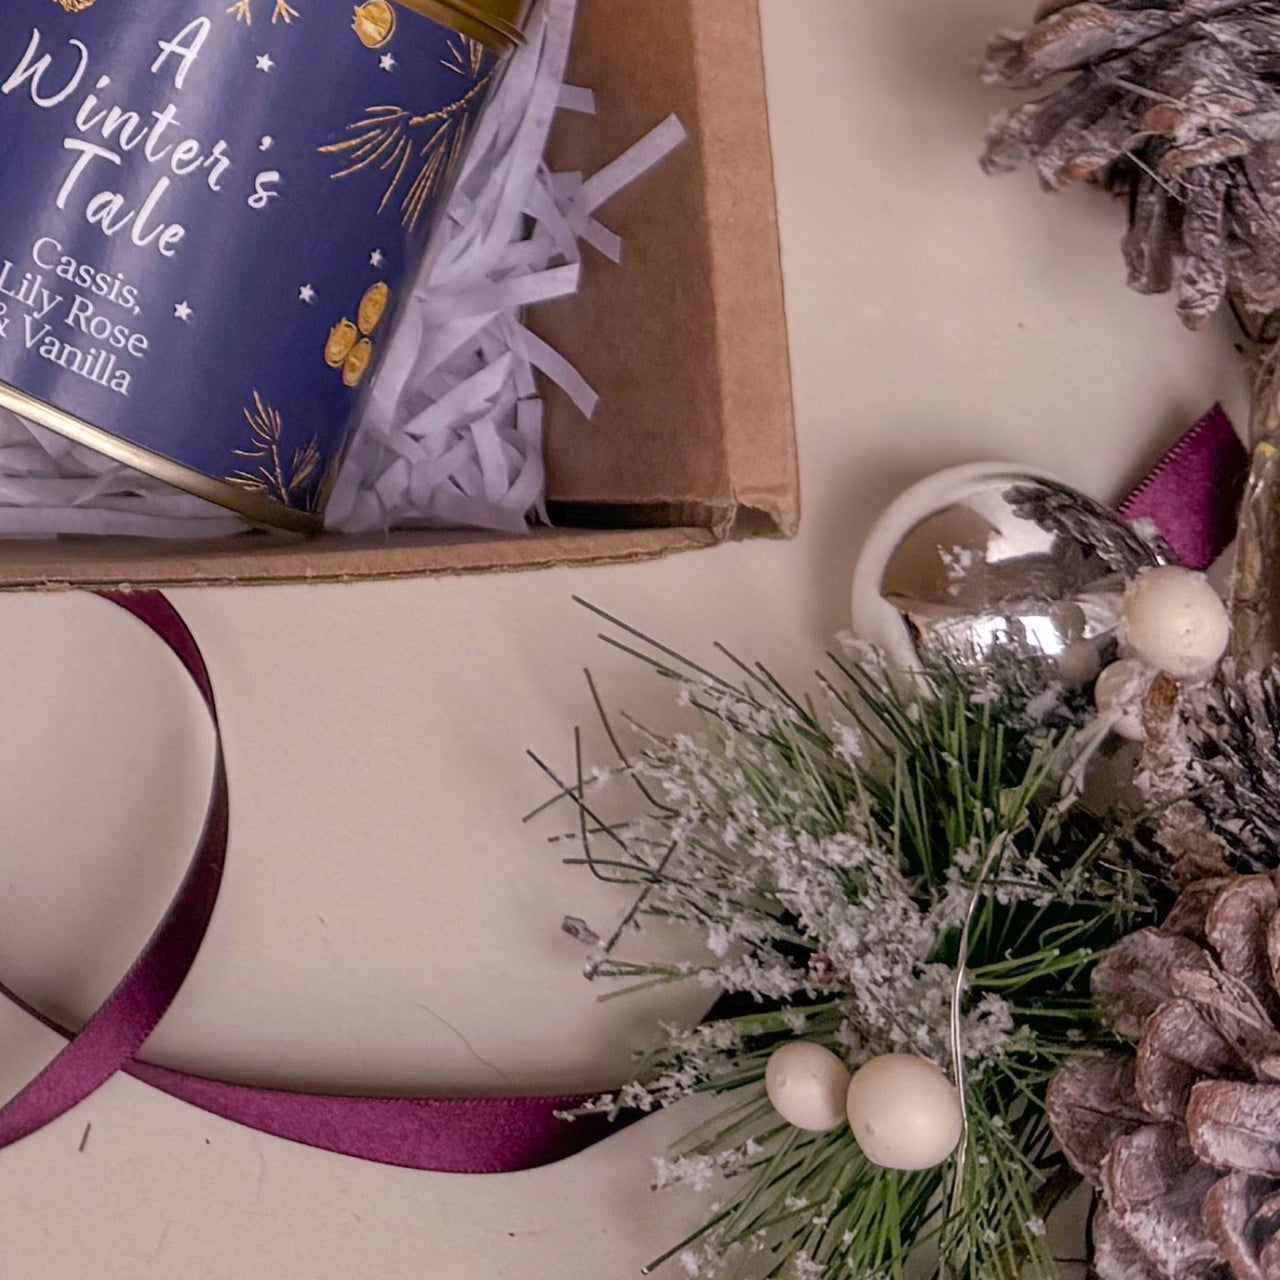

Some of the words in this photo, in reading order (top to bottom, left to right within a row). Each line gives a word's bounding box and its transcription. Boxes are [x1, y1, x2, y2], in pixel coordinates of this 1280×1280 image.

[150, 16, 211, 88] A
[0, 28, 280, 209] Winter's
[55, 137, 186, 257] Tale
[32, 236, 141, 316] Cassis,
[22, 313, 133, 397] Vanilla
[63, 293, 149, 358] Rose
